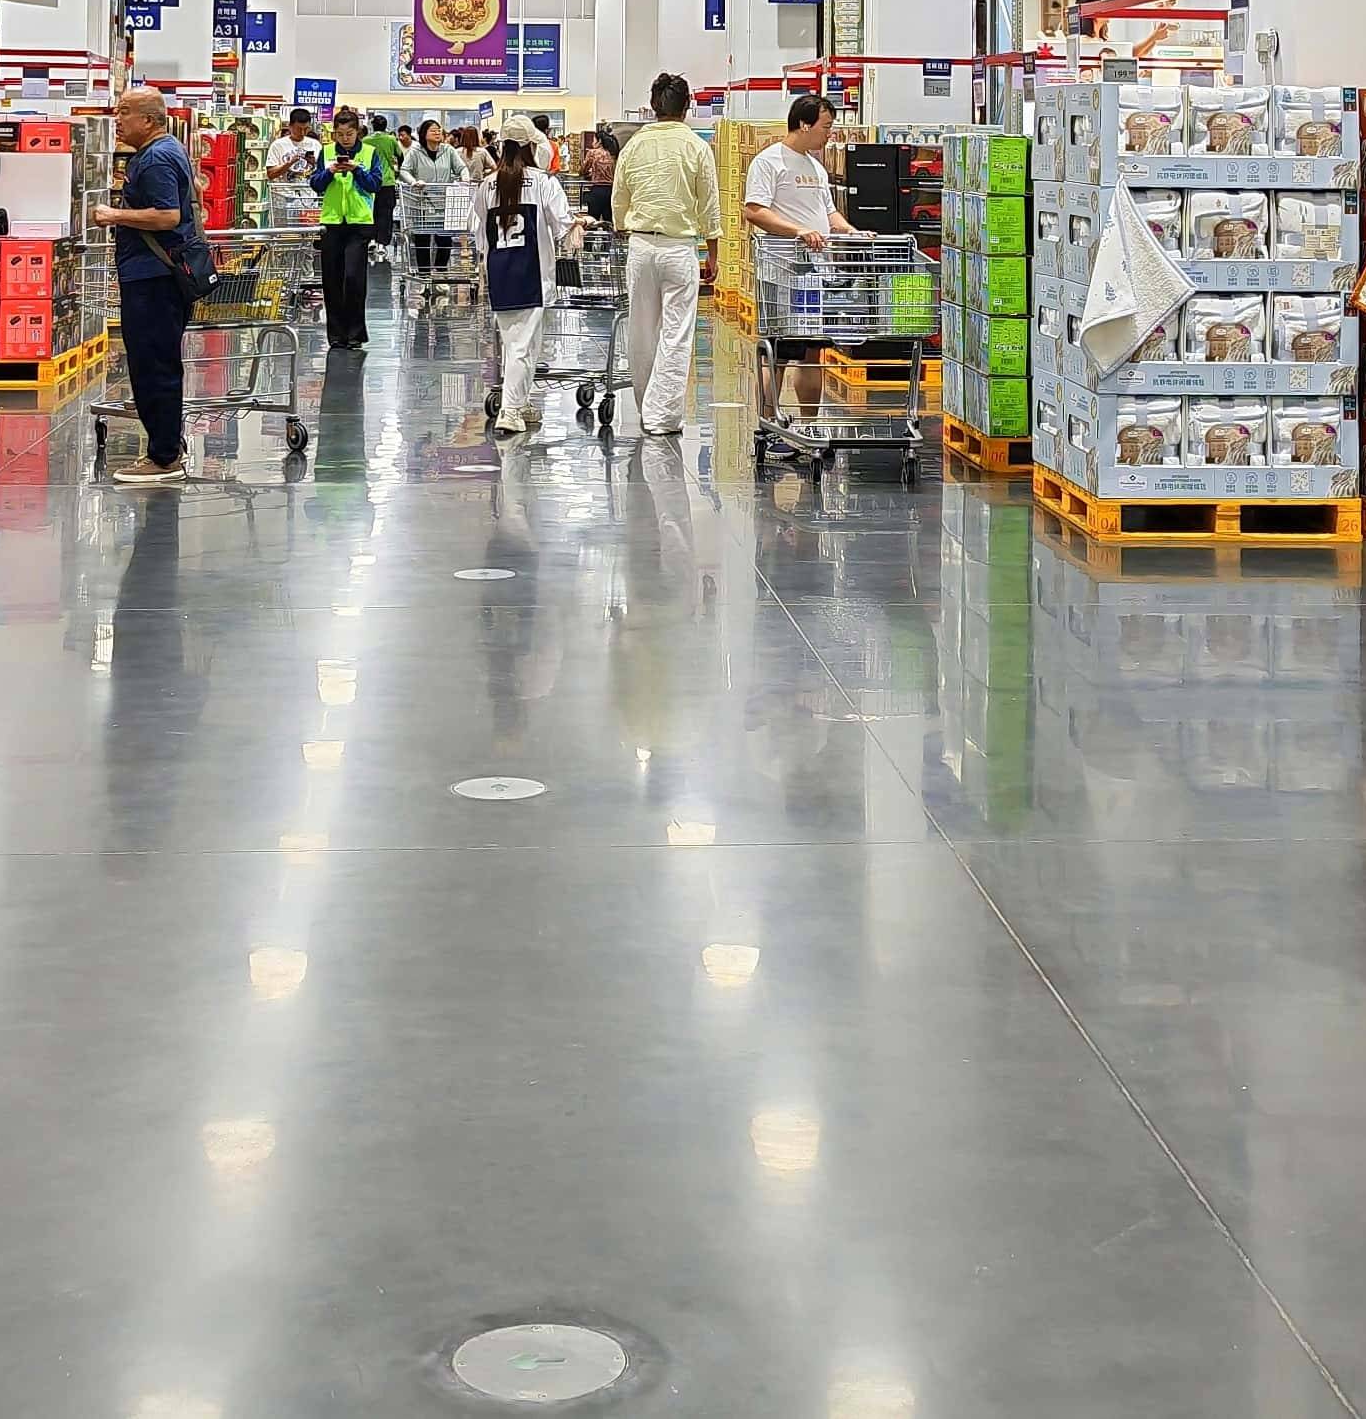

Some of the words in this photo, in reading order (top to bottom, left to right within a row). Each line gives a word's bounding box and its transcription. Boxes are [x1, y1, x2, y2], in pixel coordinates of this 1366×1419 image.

[125, 15, 154, 28] A30
[214, 24, 239, 36] A31
[246, 41, 271, 51] A34
[495, 213, 526, 250] 12
